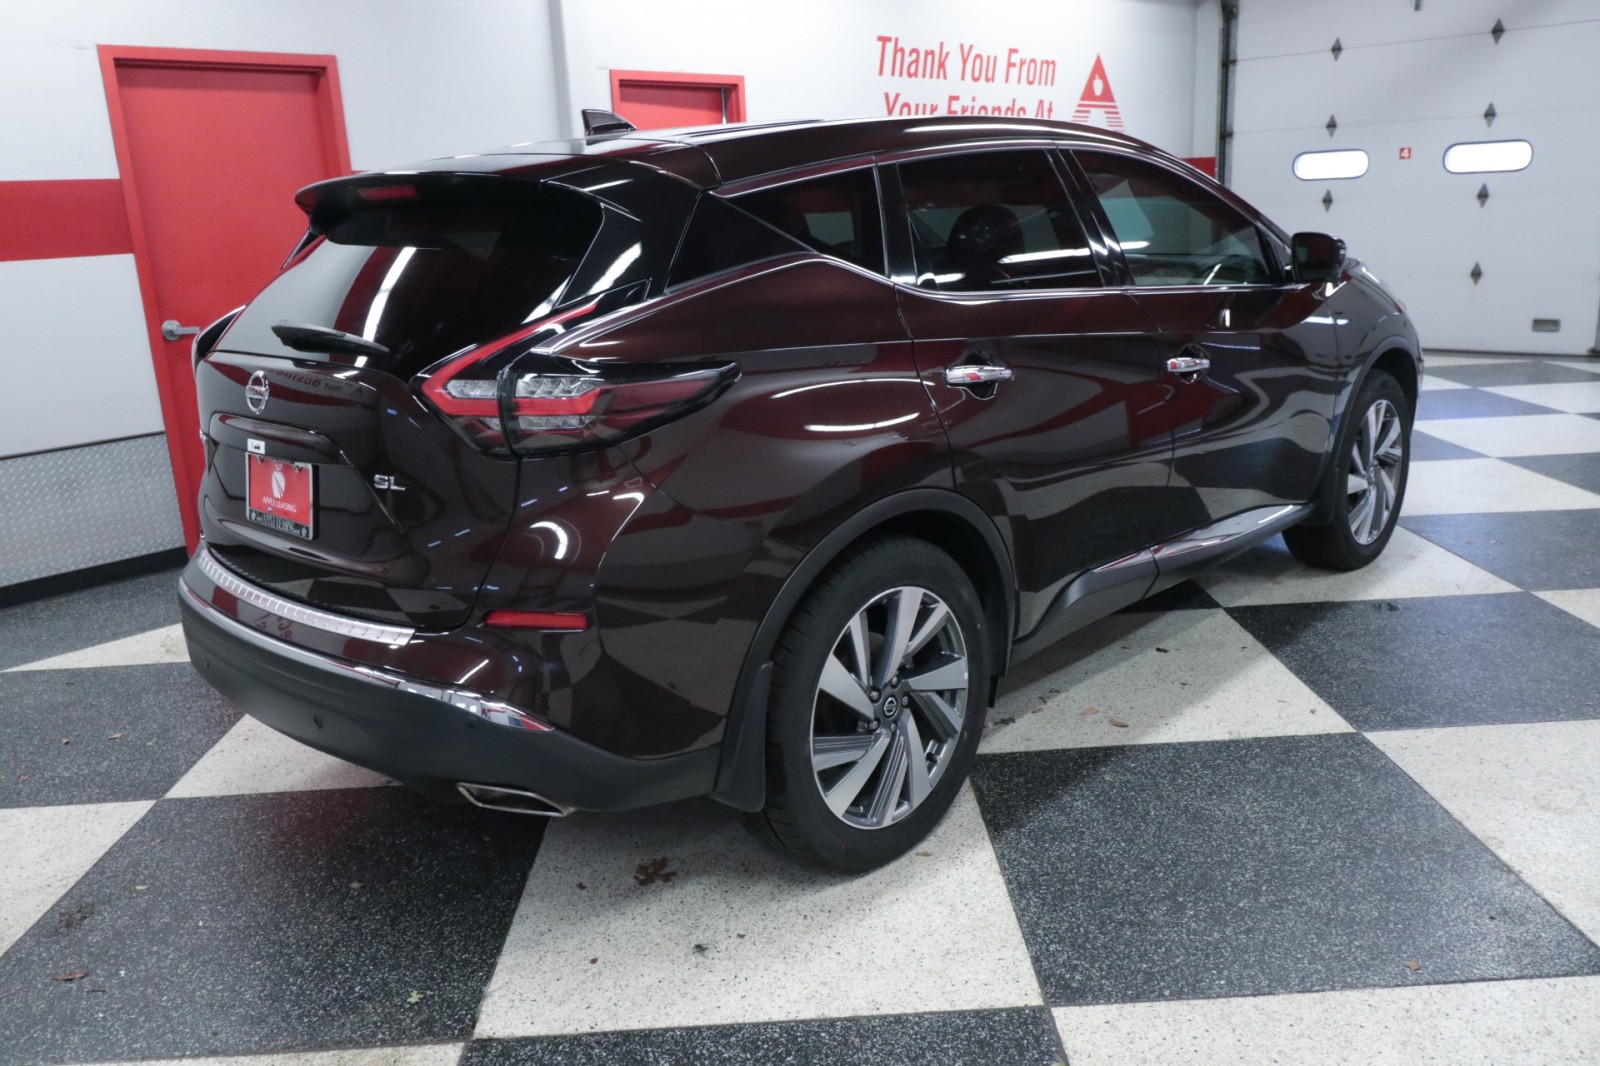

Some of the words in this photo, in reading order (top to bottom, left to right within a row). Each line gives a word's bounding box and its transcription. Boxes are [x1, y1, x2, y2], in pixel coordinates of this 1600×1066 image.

[877, 36, 949, 80] Thank
[959, 42, 997, 83] You
[1004, 47, 1056, 86] From
[1035, 99, 1053, 119] At
[373, 474, 406, 491] SL
[262, 495, 276, 507] APPLE
[276, 501, 297, 513] LEASING
